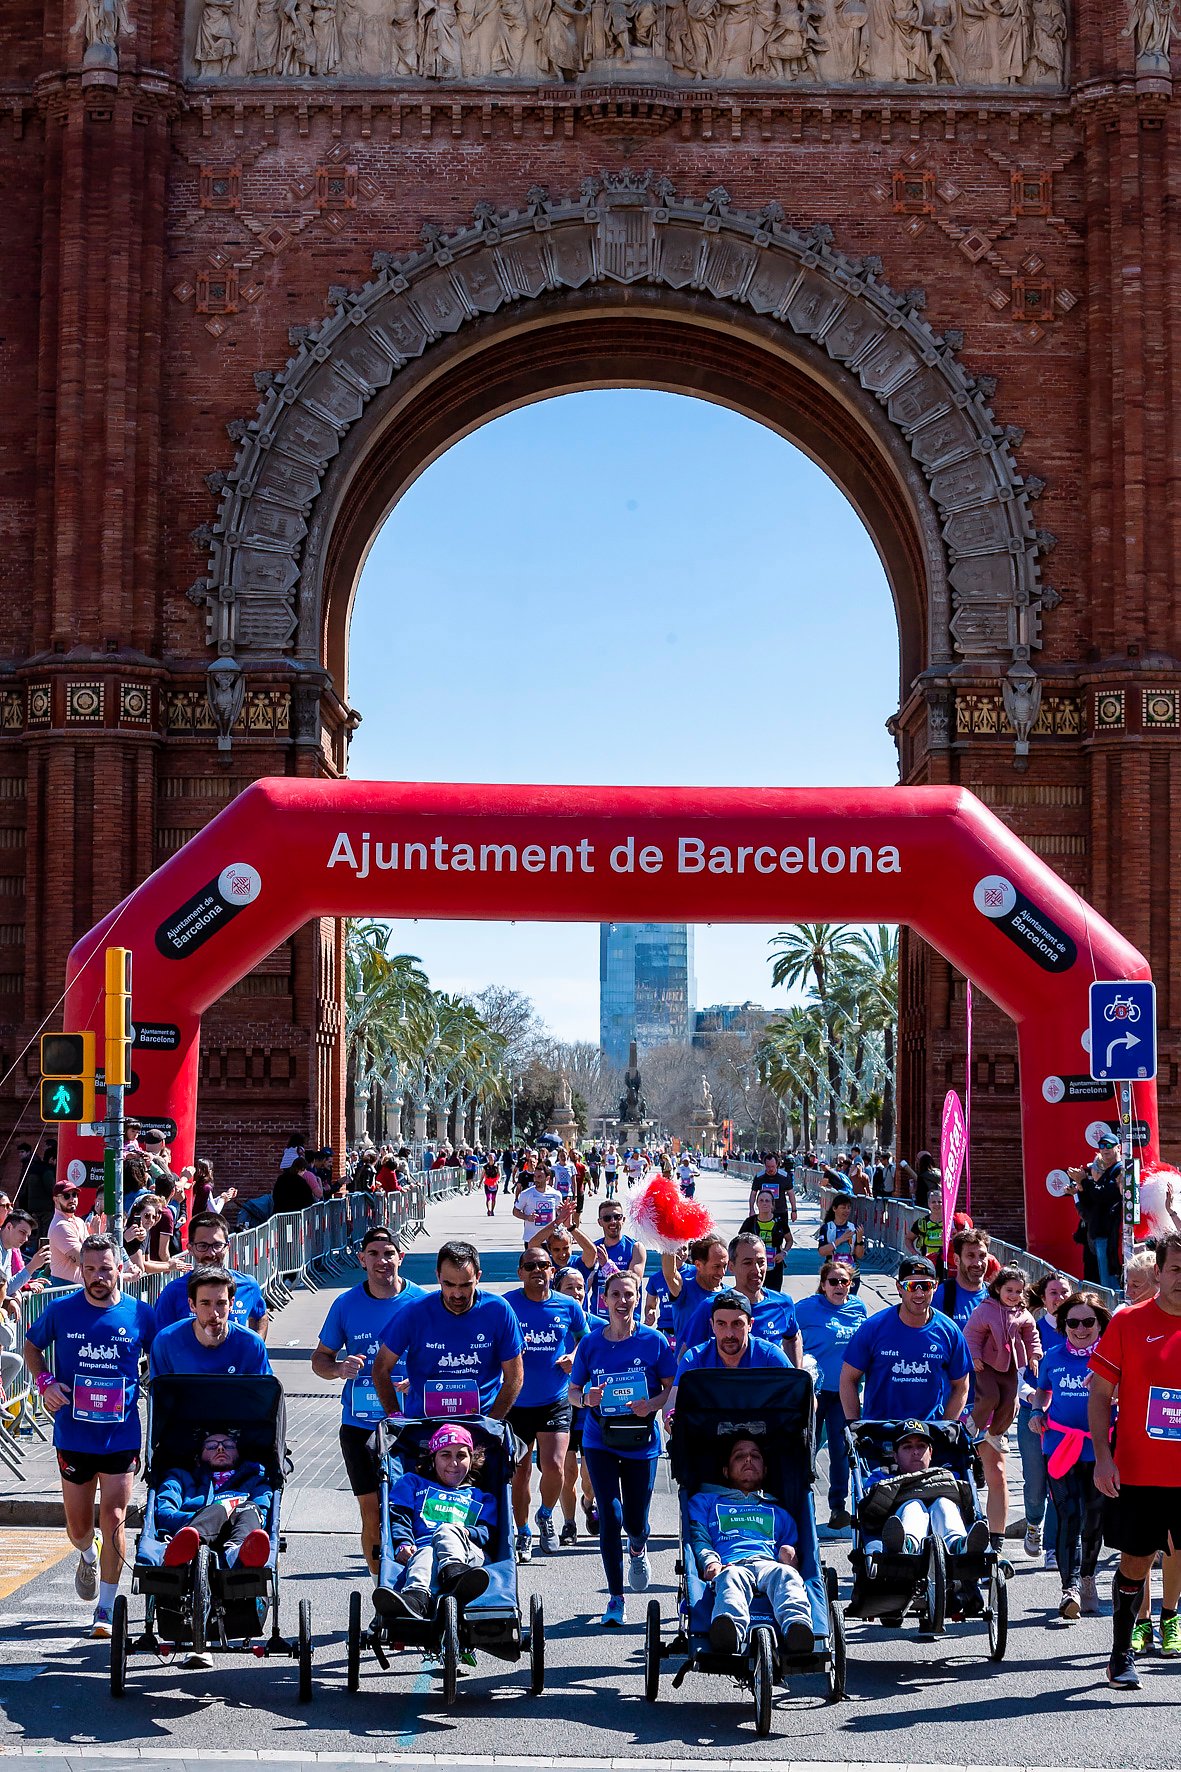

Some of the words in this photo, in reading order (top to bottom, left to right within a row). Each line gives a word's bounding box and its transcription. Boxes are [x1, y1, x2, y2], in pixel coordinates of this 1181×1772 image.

[326, 832, 595, 878] Ajuntament
[609, 836, 663, 873] de
[677, 837, 901, 873] Barcelona
[166, 903, 206, 940] Ajuntament
[204, 896, 214, 906] de
[172, 904, 223, 949] Barcelona
[1011, 916, 1059, 962] Barcelona
[1019, 909, 1058, 946] Ajuntament
[1056, 942, 1066, 952] de
[140, 1034, 175, 1044] Barcelona
[1069, 1086, 1108, 1095] Barcelona
[79, 1362, 118, 1370] #Imparables
